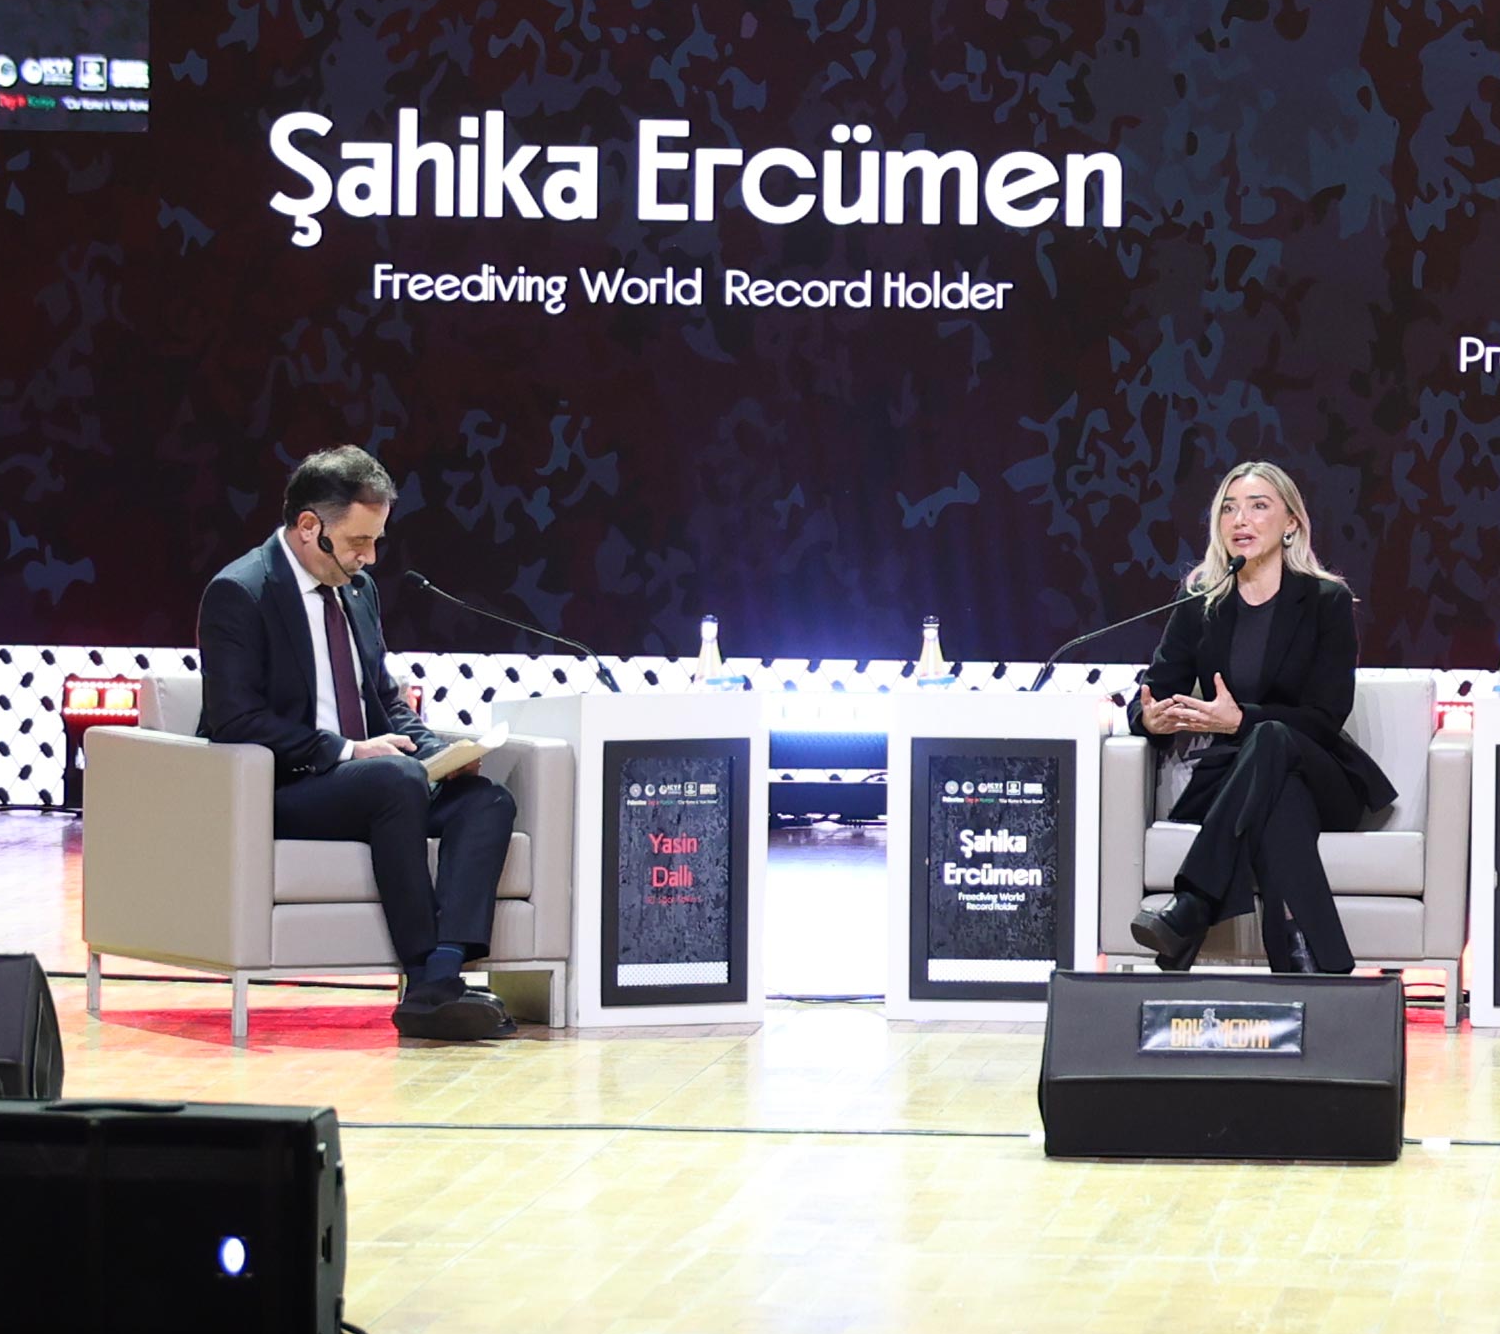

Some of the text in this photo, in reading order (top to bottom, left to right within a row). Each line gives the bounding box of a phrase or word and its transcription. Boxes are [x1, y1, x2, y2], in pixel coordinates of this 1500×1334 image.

[270, 108, 1123, 248] Şahika Ercümen
[374, 264, 1014, 315] Freediving World Record Holder
[648, 832, 698, 854] Yasin
[960, 828, 1027, 859] Şahika
[944, 862, 1042, 886] Ercümen
[958, 892, 1026, 903] Freediving World
